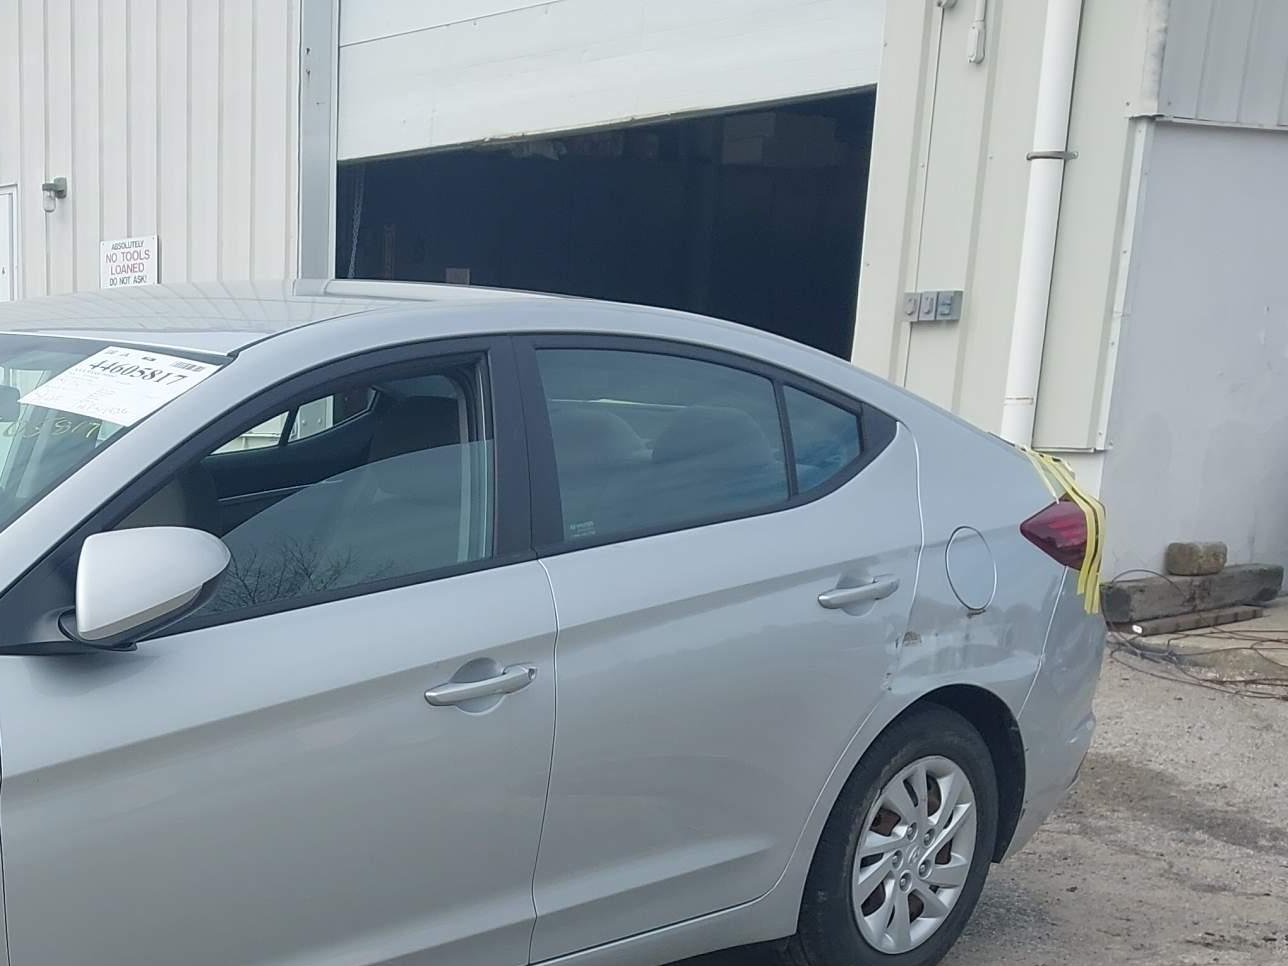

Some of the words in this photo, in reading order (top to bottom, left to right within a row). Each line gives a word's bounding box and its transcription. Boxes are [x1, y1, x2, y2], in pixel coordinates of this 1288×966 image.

[112, 240, 144, 250] ABSOLUTELY
[106, 253, 117, 264] NO
[121, 250, 150, 262] TOOLS
[111, 263, 144, 275] LOANED
[109, 277, 117, 286] DO
[119, 276, 130, 285] NOT
[133, 275, 147, 283] ASK!
[88, 358, 188, 386] 44605817
